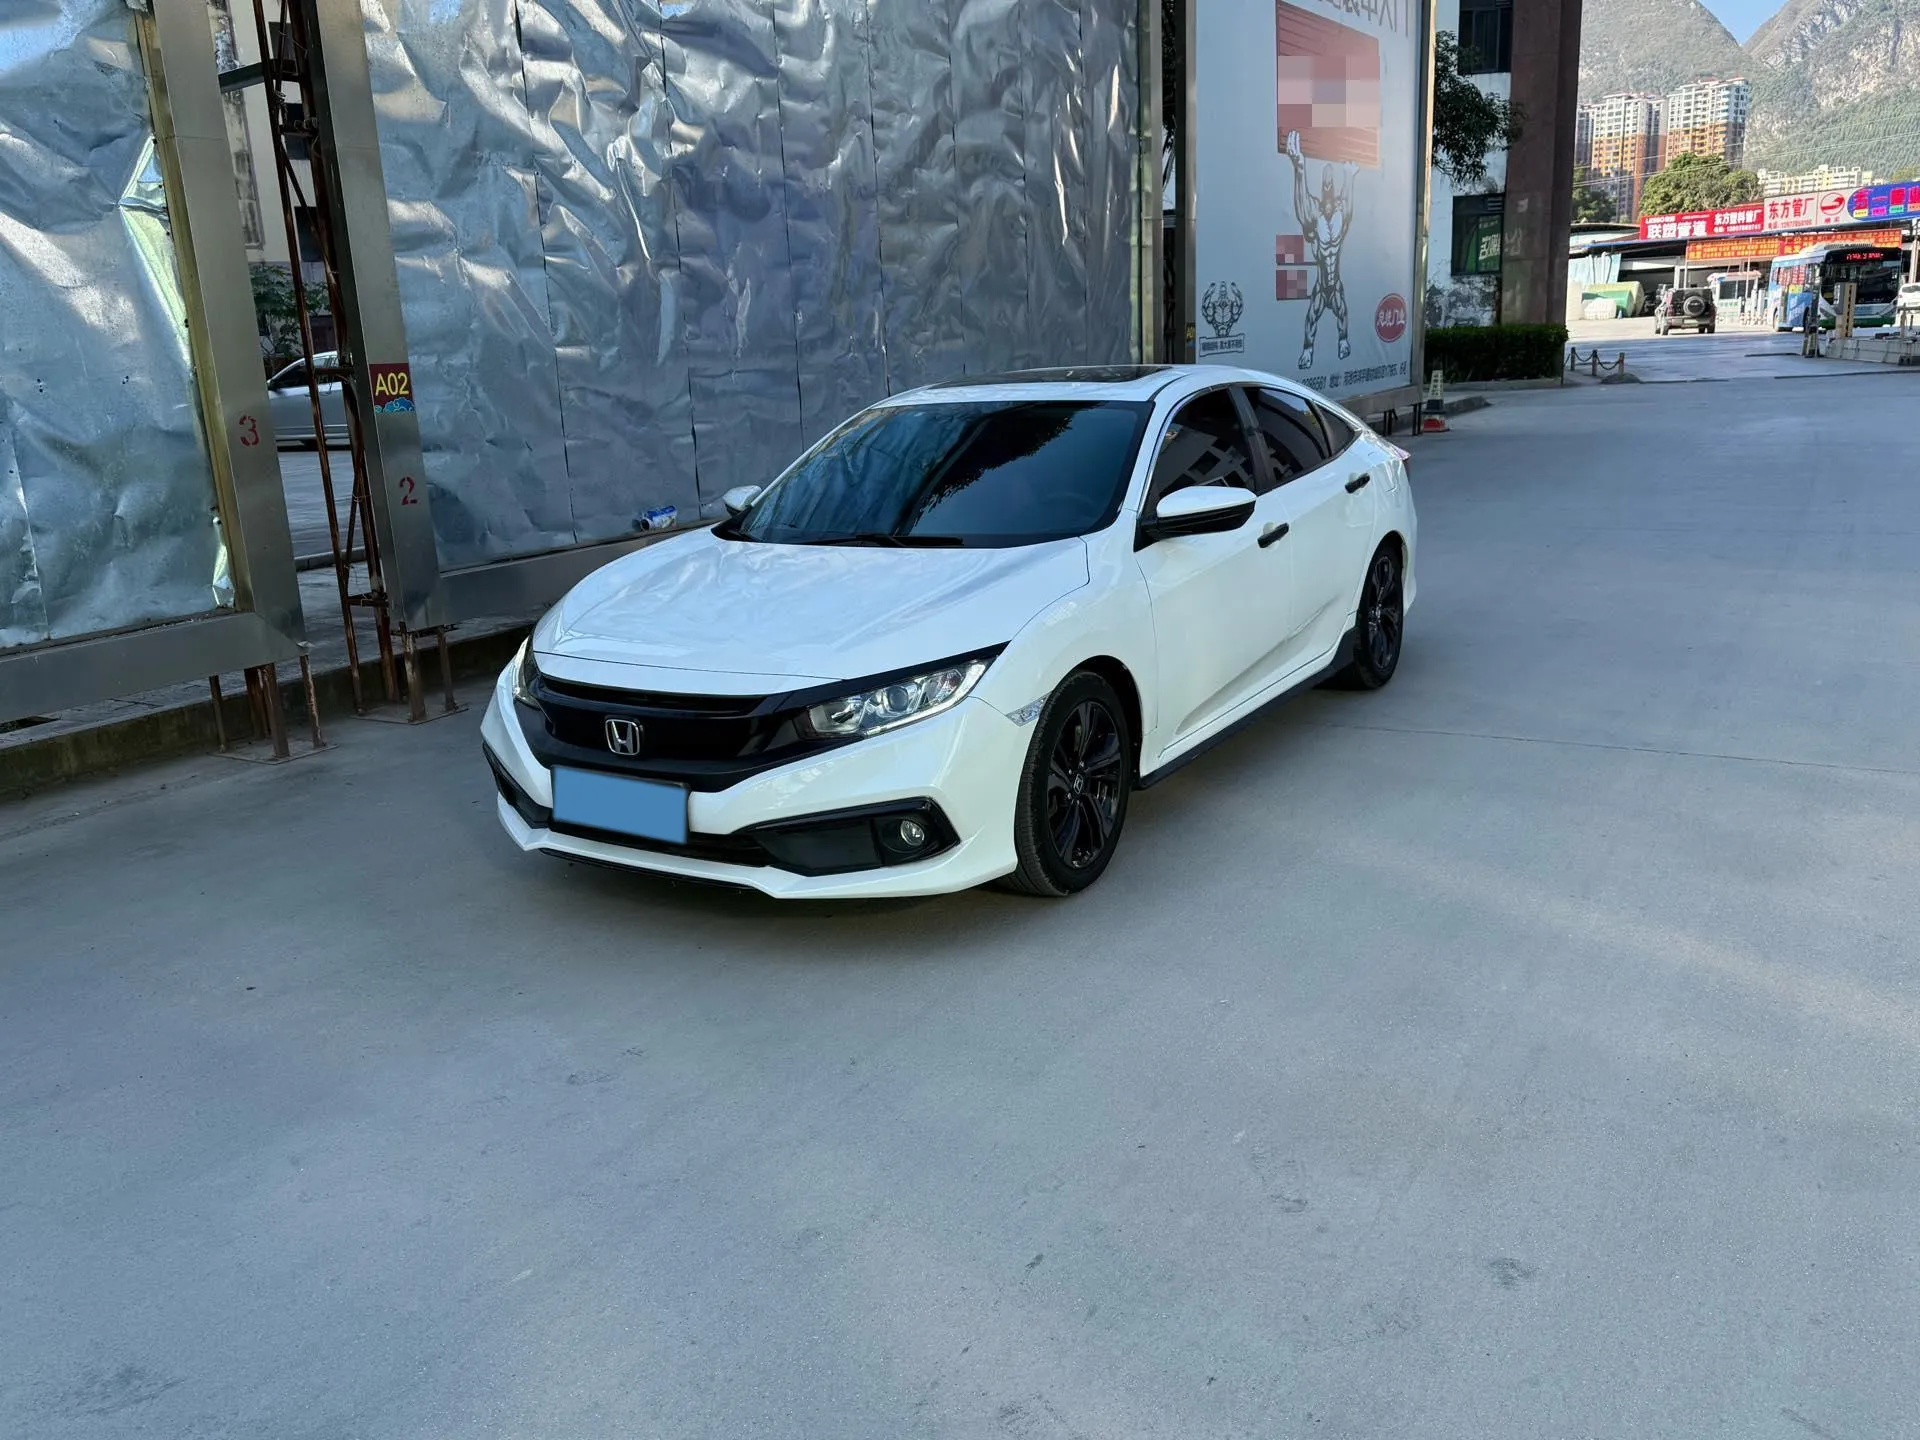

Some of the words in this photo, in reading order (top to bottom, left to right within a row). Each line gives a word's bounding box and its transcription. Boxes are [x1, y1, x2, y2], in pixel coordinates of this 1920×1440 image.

[1768, 197, 1815, 220] 东方管厂
[1647, 221, 1707, 240] 联塑管道
[375, 372, 410, 397] A02
[239, 415, 260, 447] 3
[399, 476, 418, 506] 2
